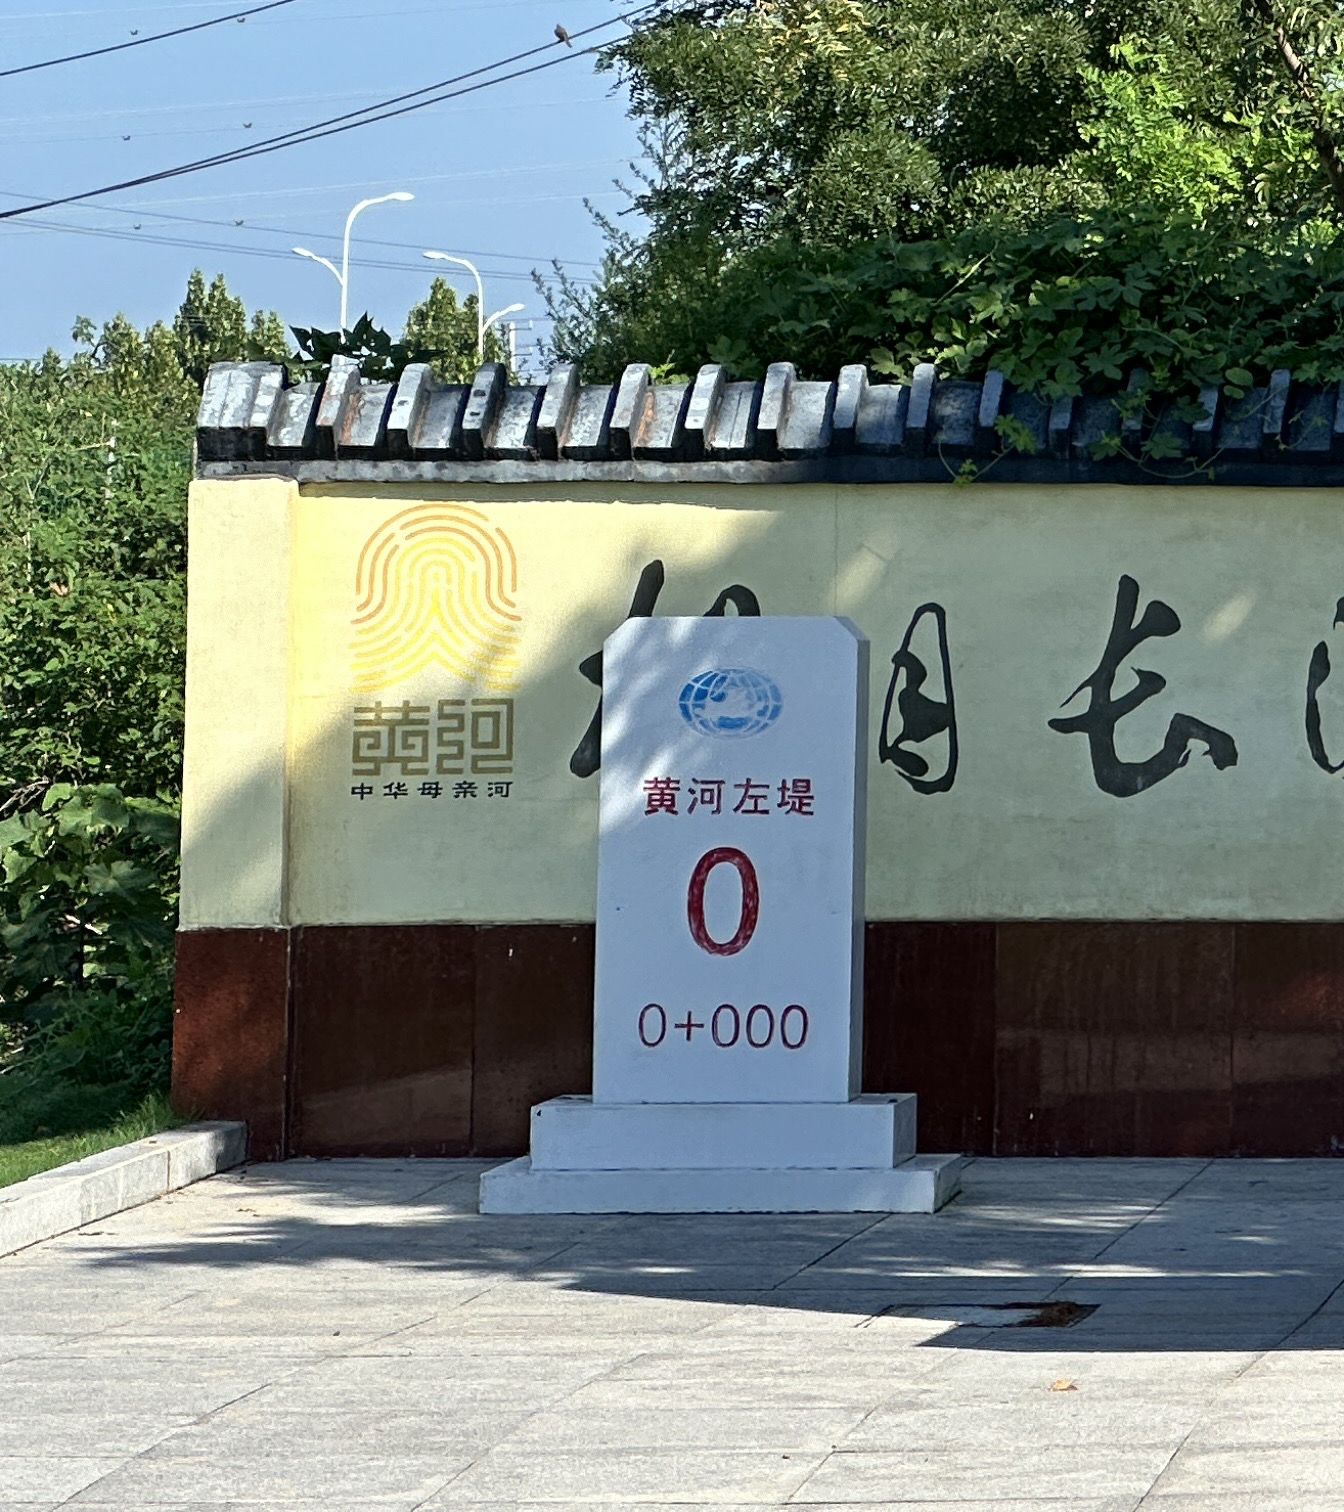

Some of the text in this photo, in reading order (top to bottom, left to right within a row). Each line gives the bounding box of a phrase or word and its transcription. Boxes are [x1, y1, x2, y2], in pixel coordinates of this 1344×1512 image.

[350, 780, 513, 801] 中华母亲河
[643, 777, 816, 816] 黄河左堤
[687, 847, 760, 956] 0
[638, 1003, 810, 1050] 0+000
